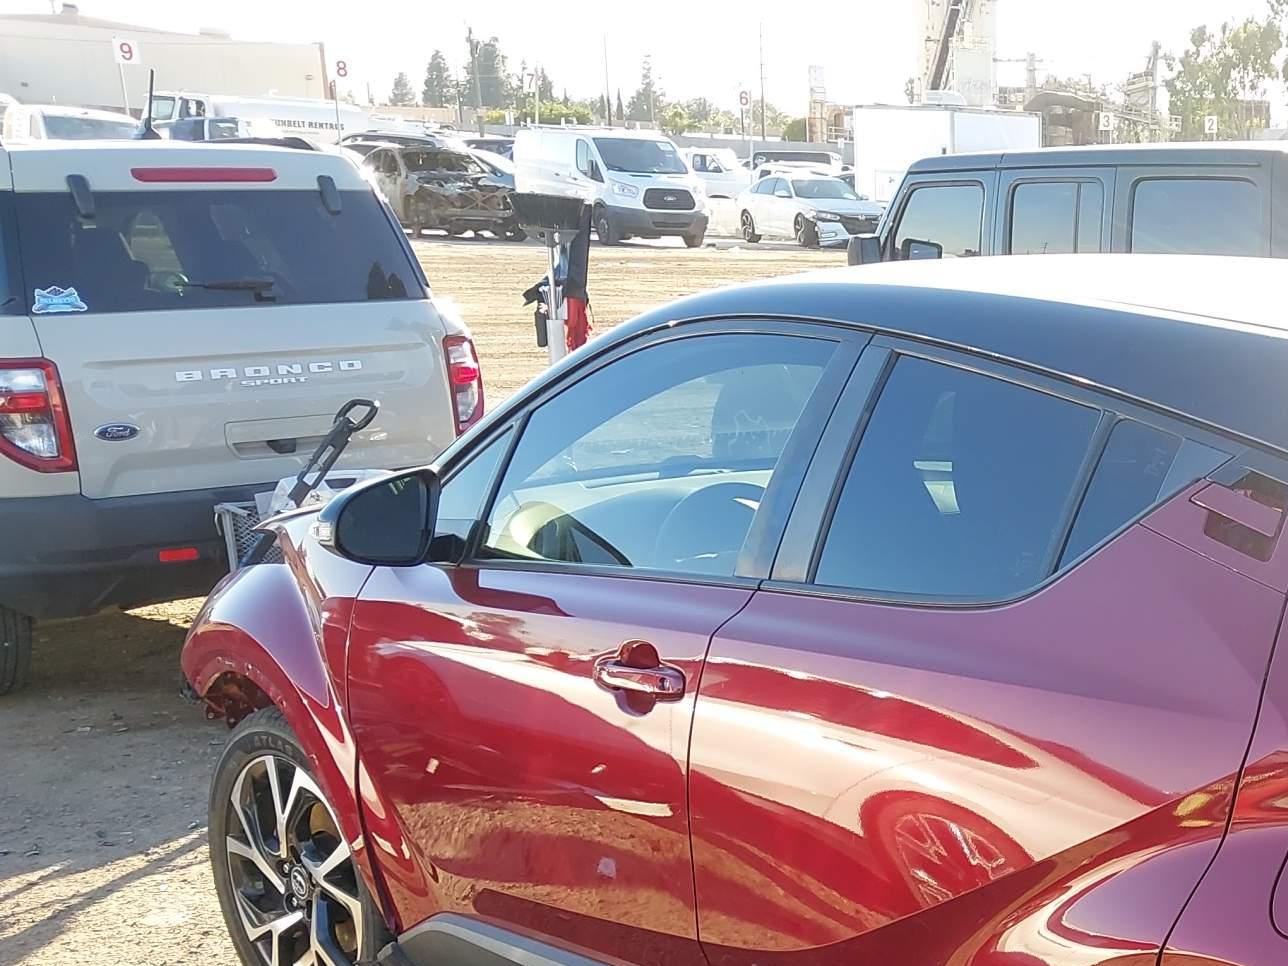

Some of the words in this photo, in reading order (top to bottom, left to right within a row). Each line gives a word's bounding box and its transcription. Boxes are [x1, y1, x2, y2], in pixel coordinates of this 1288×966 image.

[119, 42, 133, 60] 9
[336, 60, 348, 77] 8
[739, 91, 749, 107] 6
[1102, 114, 1111, 129] 3
[1207, 118, 1215, 131] 2
[175, 360, 362, 382] BRONCO
[240, 376, 309, 387] SPORT
